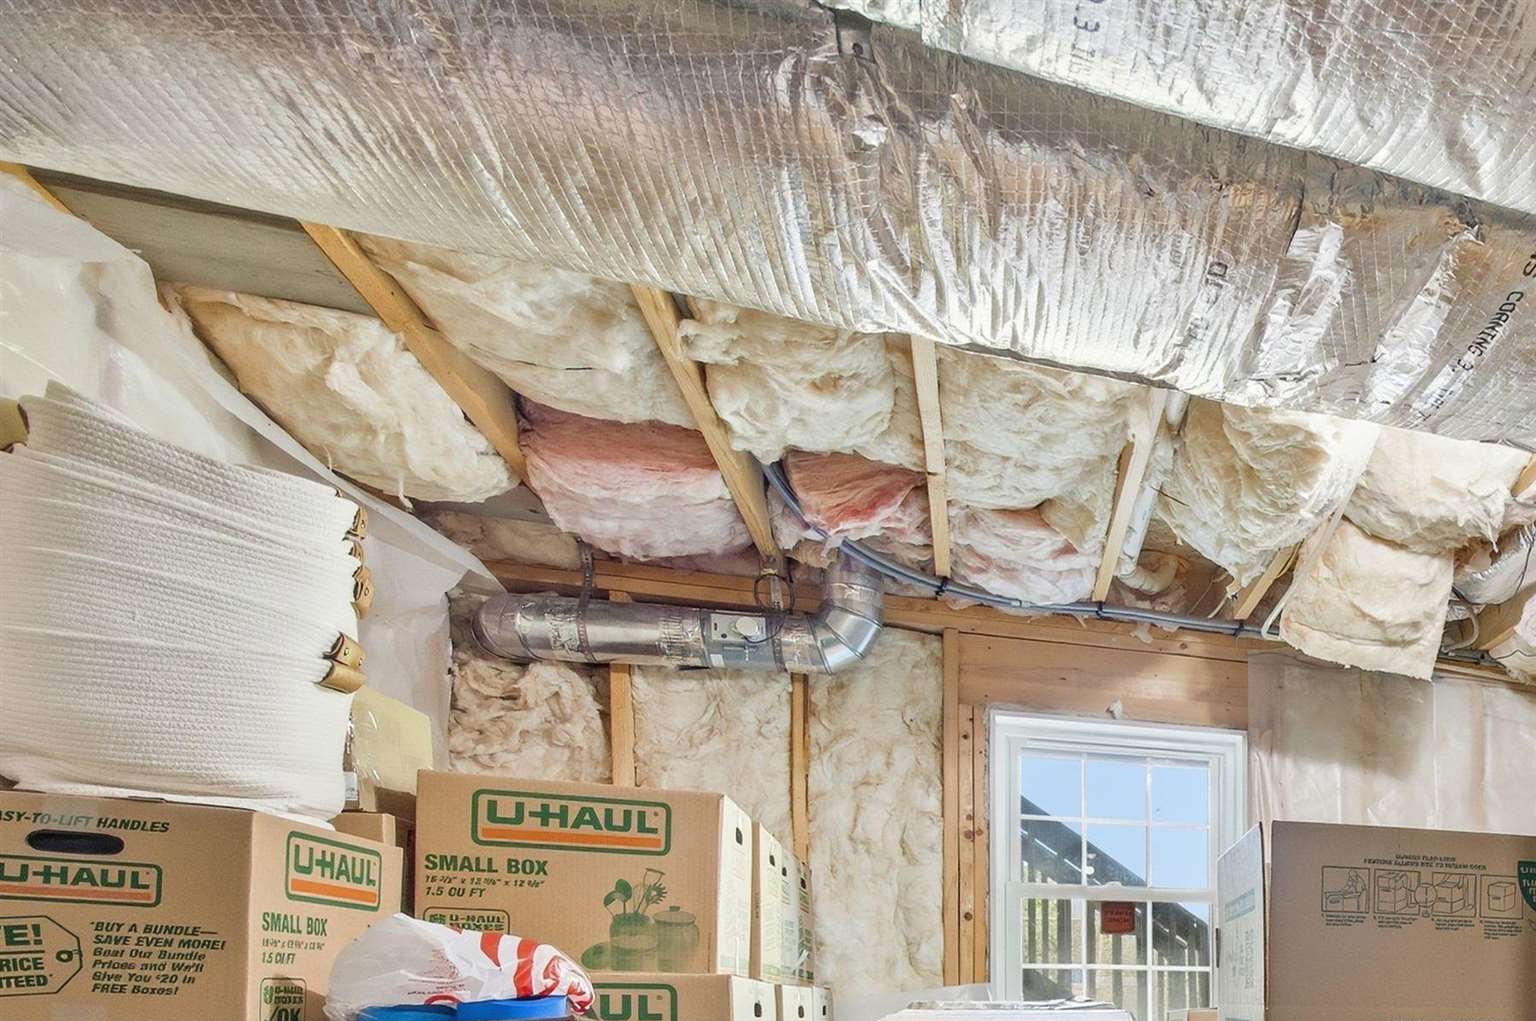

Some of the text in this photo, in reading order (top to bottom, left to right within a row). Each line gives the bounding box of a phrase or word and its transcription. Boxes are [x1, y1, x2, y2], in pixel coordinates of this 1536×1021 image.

[1468, 291, 1524, 357] CORNING
[488, 800, 659, 834] U-HAUL
[96, 817, 170, 832] HANDLES
[294, 844, 376, 887] U-HAUL
[424, 854, 548, 875] SMALL BOX
[0, 863, 150, 889] U-HAUL
[470, 888, 485, 897] FT
[128, 923, 138, 933] A
[262, 912, 327, 936] SMALL BOX
[93, 936, 130, 945] SAVE
[135, 936, 173, 947] EVEN
[158, 950, 206, 961] Bundle
[140, 962, 166, 971] and
[128, 973, 151, 982] You
[92, 984, 127, 993] FREE
